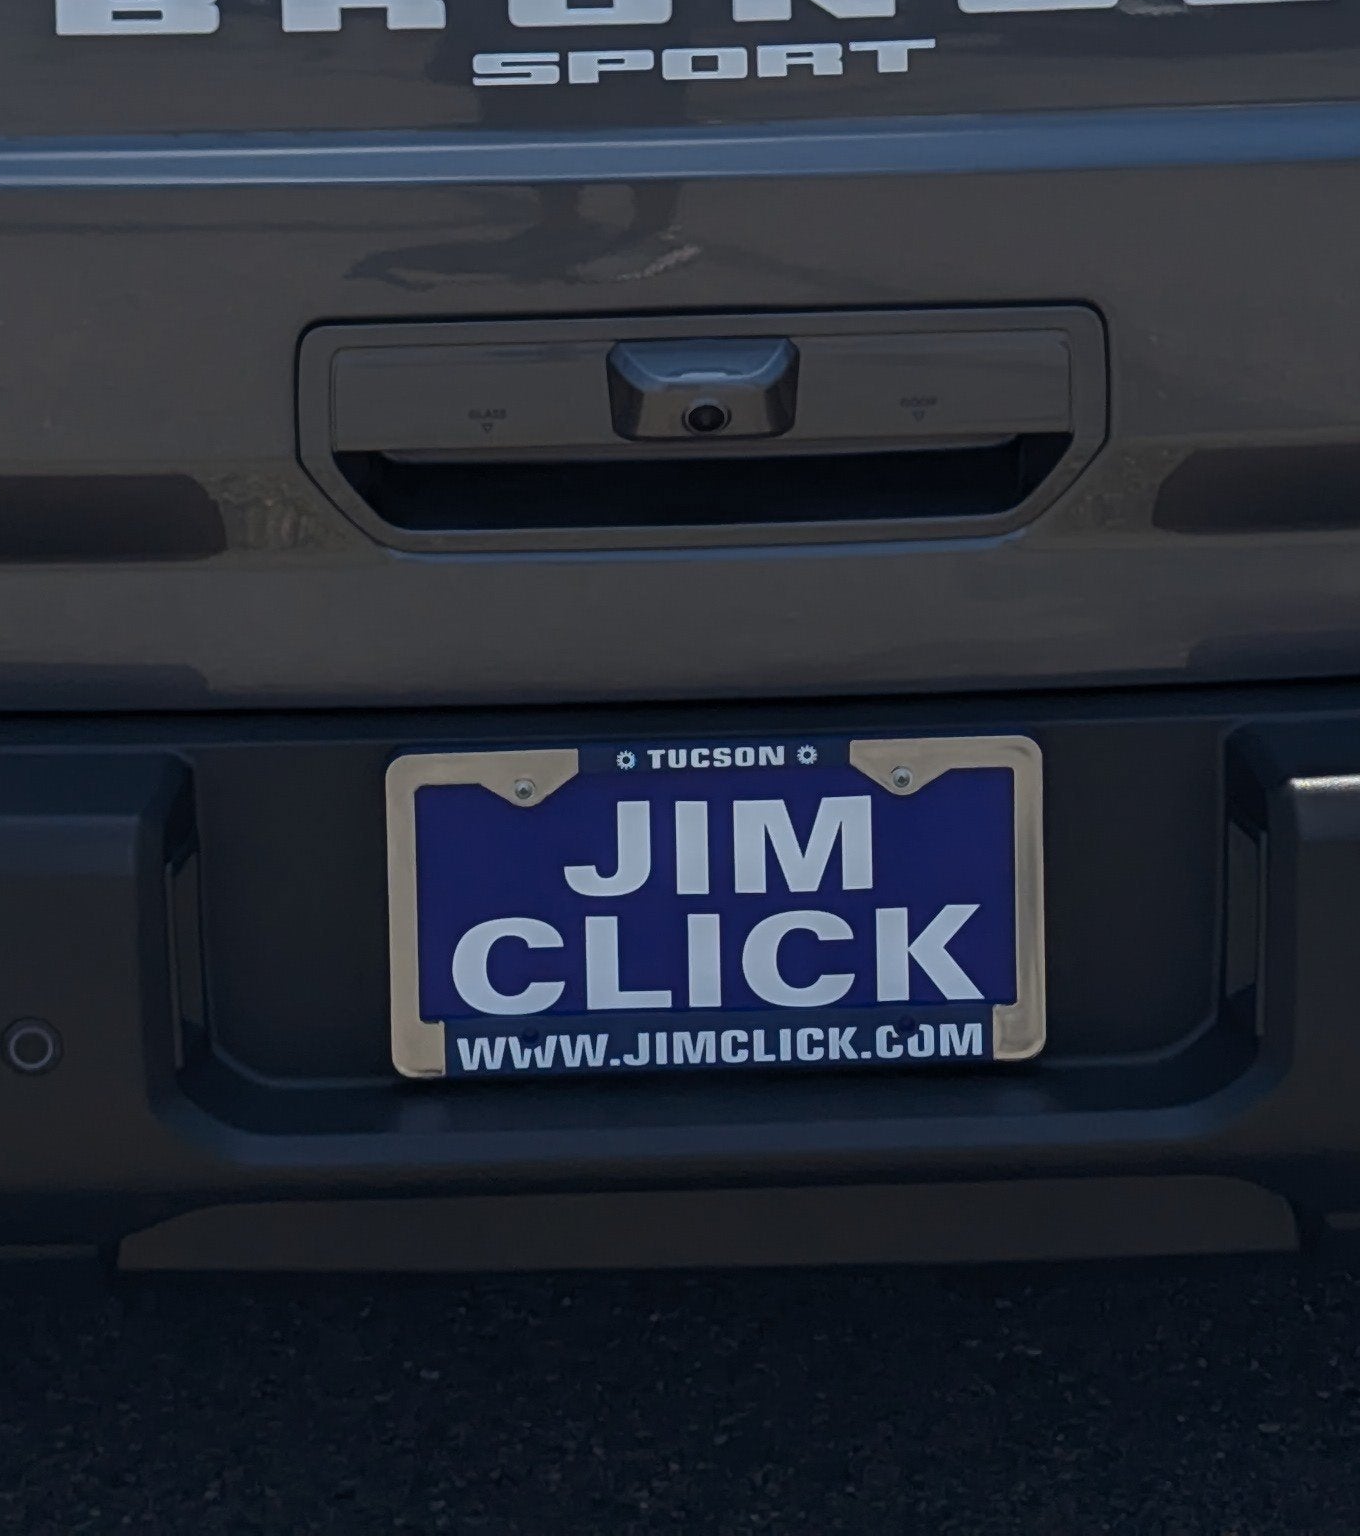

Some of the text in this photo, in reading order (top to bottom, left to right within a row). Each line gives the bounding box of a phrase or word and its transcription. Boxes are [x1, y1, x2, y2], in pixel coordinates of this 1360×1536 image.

[472, 38, 936, 87] SPORT
[647, 745, 785, 770] TUCSON
[563, 795, 873, 897] JIM
[451, 903, 985, 1016] CLICK
[456, 1022, 983, 1071] WWW.JIMCLICK.COM
